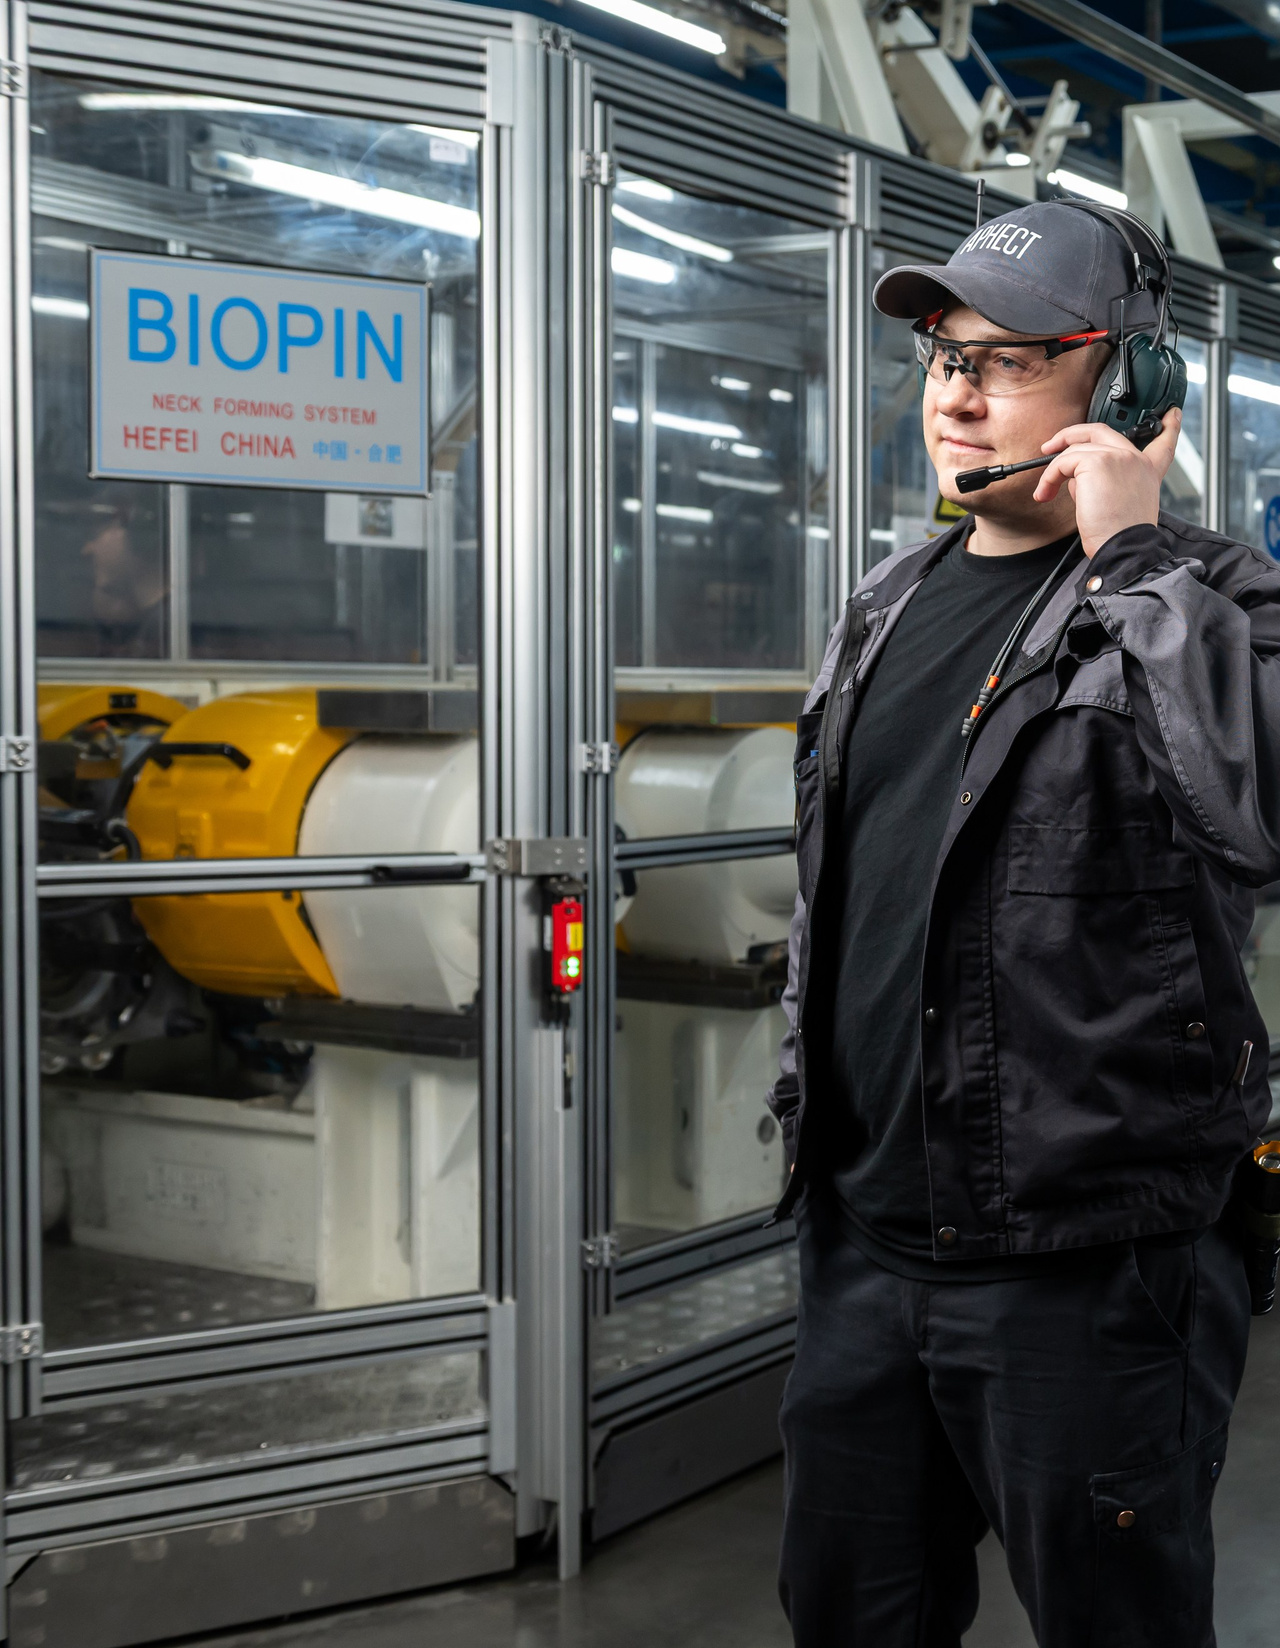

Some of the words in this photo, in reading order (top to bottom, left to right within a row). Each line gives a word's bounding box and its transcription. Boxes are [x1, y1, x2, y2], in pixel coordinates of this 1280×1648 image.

[128, 287, 402, 383] BIOPIN
[153, 394, 202, 413] NECK
[214, 398, 294, 420] FORMING
[304, 405, 377, 425] SYSTEM
[123, 426, 198, 452] HEFEI
[221, 431, 296, 459] CHINA
